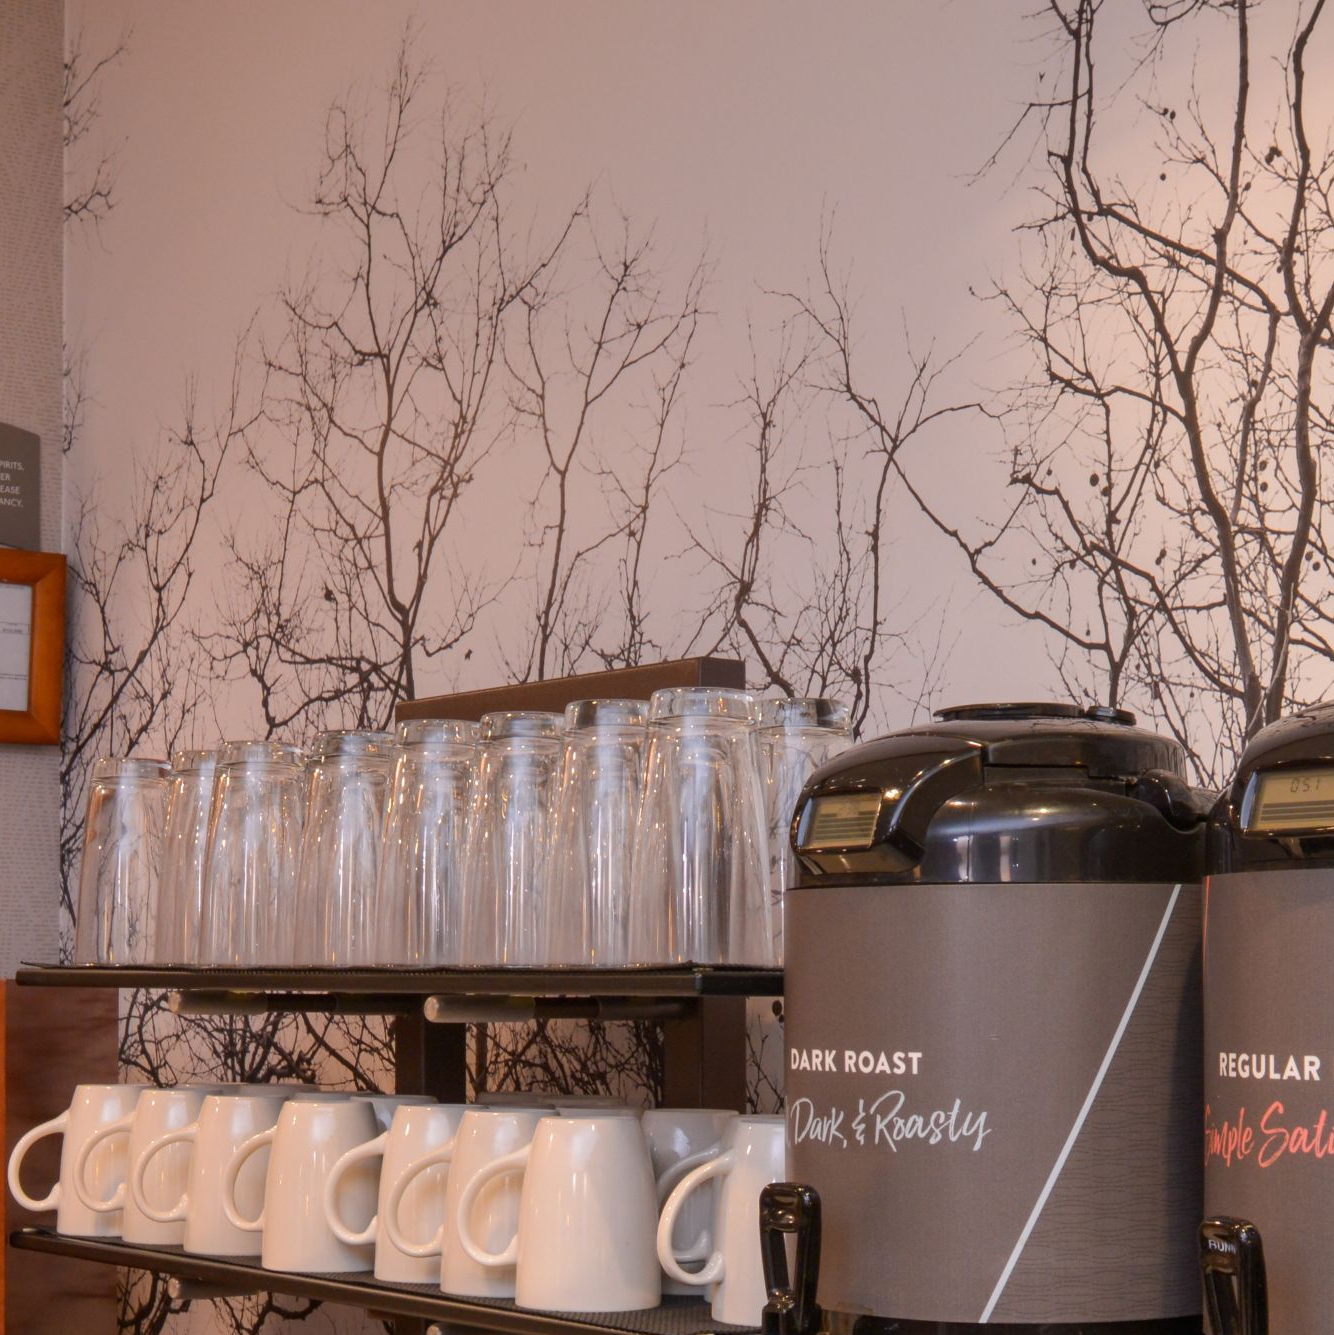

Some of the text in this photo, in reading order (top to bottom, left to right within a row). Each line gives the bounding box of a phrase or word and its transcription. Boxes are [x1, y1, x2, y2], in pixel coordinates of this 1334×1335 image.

[790, 1048, 923, 1075] DARK ROAST
[1219, 1052, 1322, 1082] REGULAR
[870, 1090, 992, 1152] Roasty
